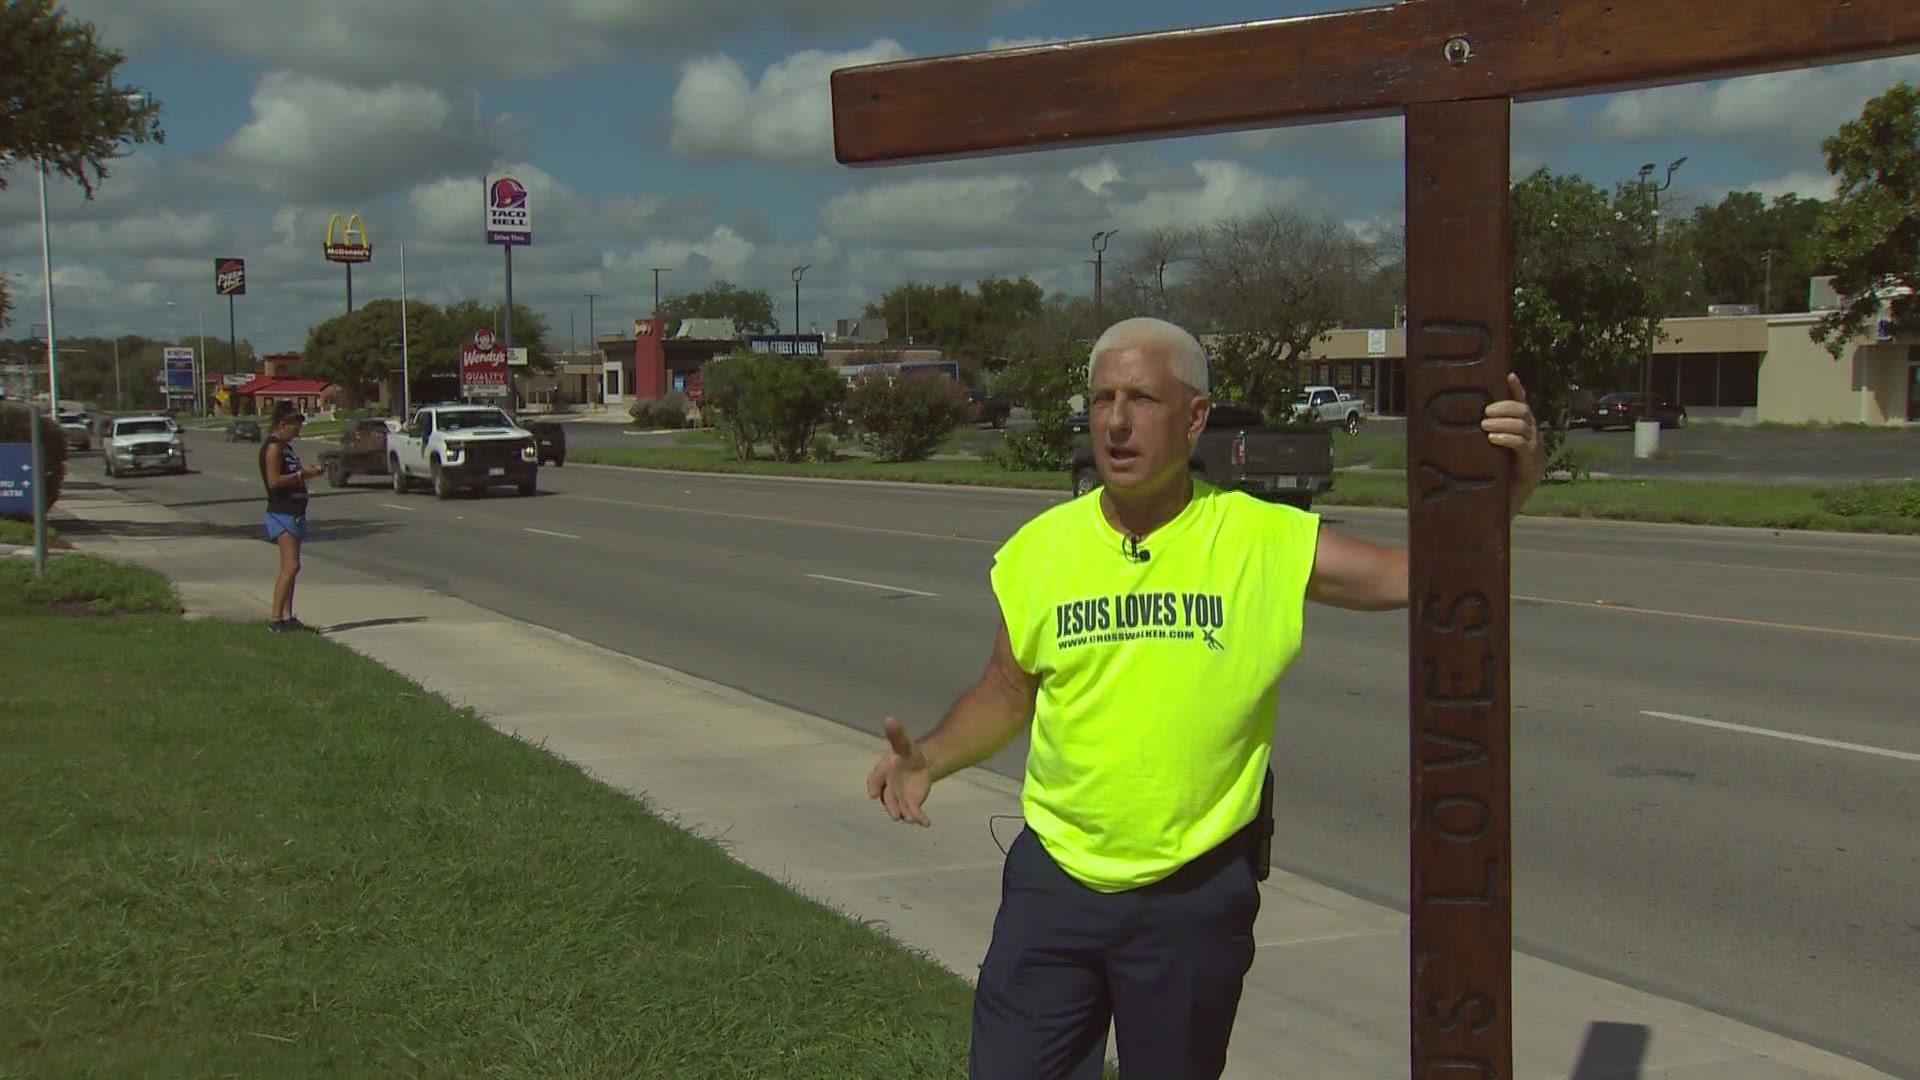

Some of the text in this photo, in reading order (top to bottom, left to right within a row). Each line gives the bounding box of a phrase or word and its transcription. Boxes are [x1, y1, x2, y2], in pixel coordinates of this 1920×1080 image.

[327, 248, 369, 256] McDonald's
[217, 270, 243, 287] Pizza
[770, 341, 793, 354] STREET
[463, 349, 506, 367] Wendy's
[1418, 318, 1497, 504] YOU
[1056, 592, 1223, 638] JESUS LOVES YOU
[1421, 591, 1495, 905] LOVES
